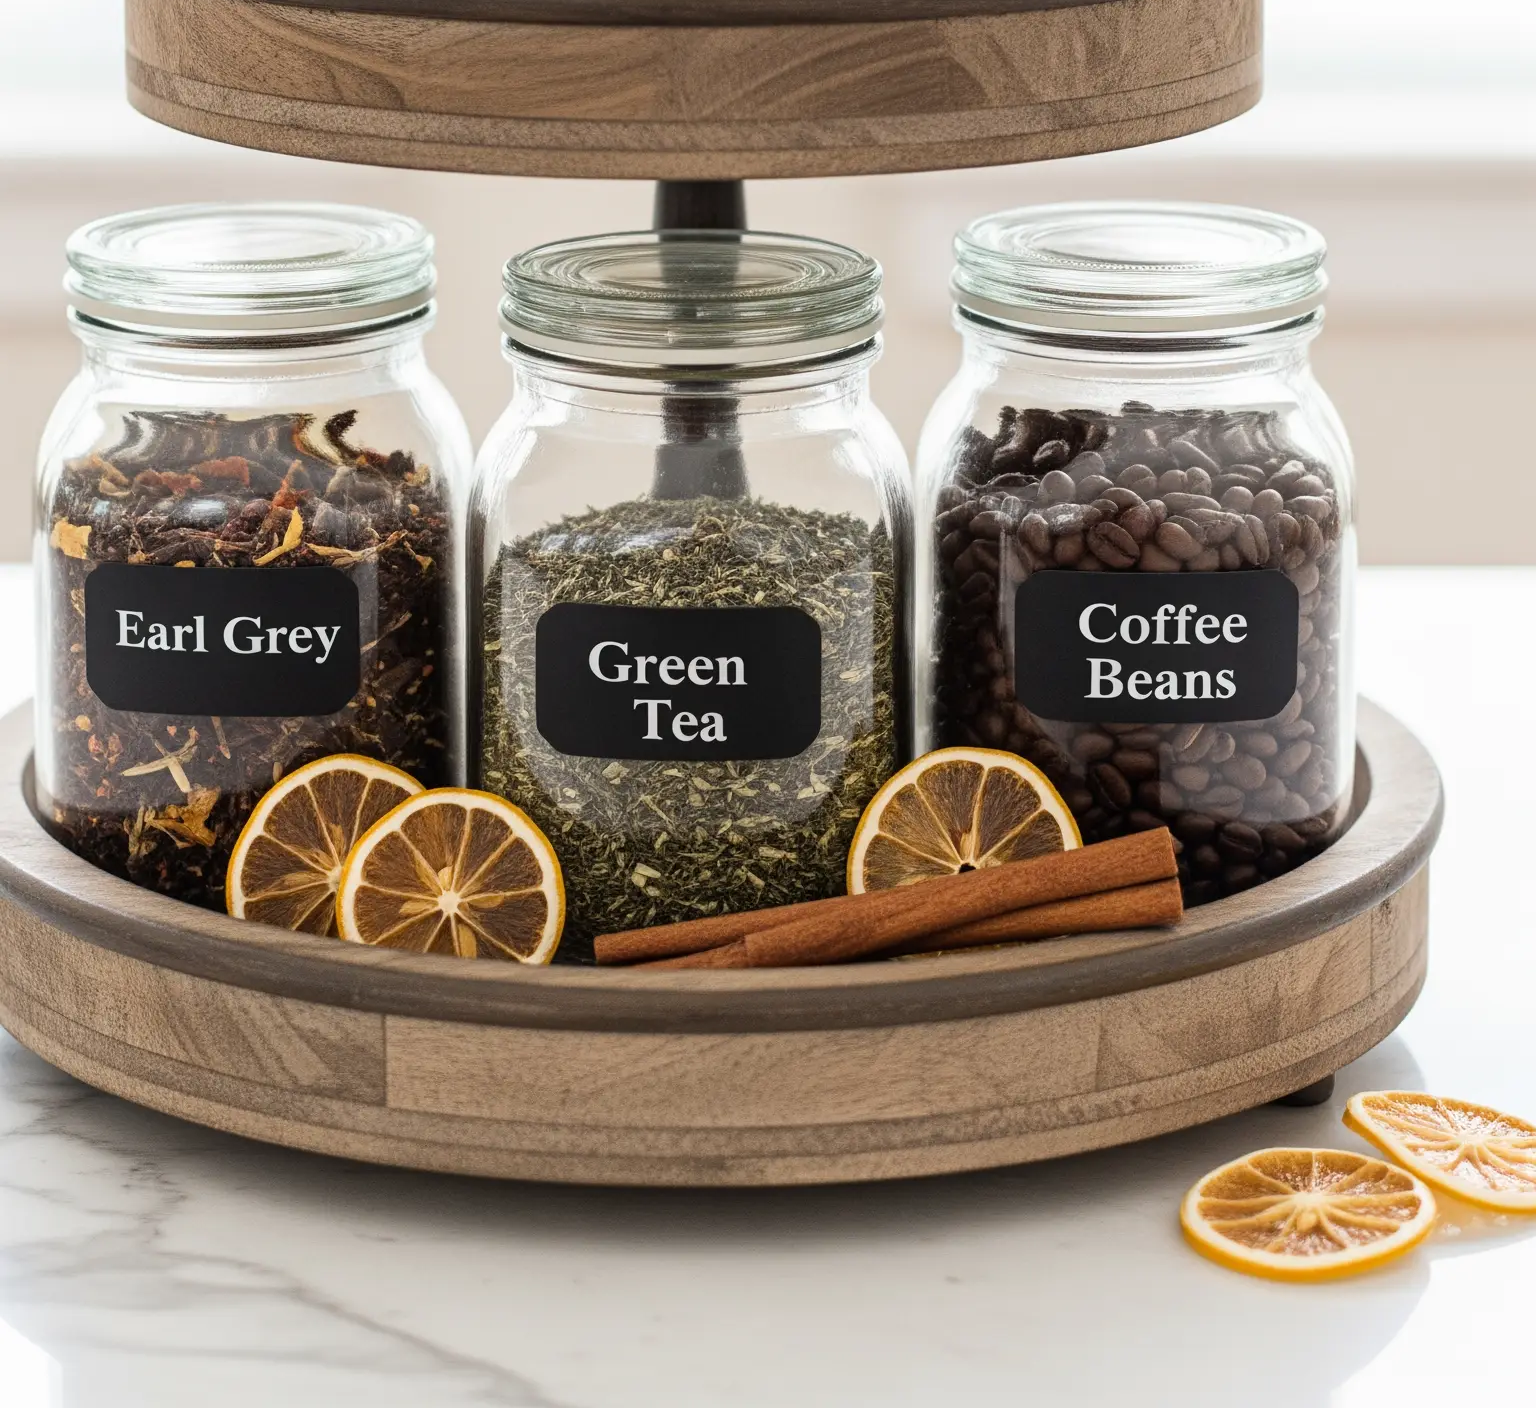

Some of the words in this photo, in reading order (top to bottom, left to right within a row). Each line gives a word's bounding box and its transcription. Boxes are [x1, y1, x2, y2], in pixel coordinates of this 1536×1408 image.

[115, 609, 209, 653] Earl
[223, 616, 341, 664] Grey
[1078, 602, 1248, 645] Coffee
[588, 641, 748, 686] Green
[1083, 657, 1237, 700] Beans
[633, 698, 728, 743] Tea
